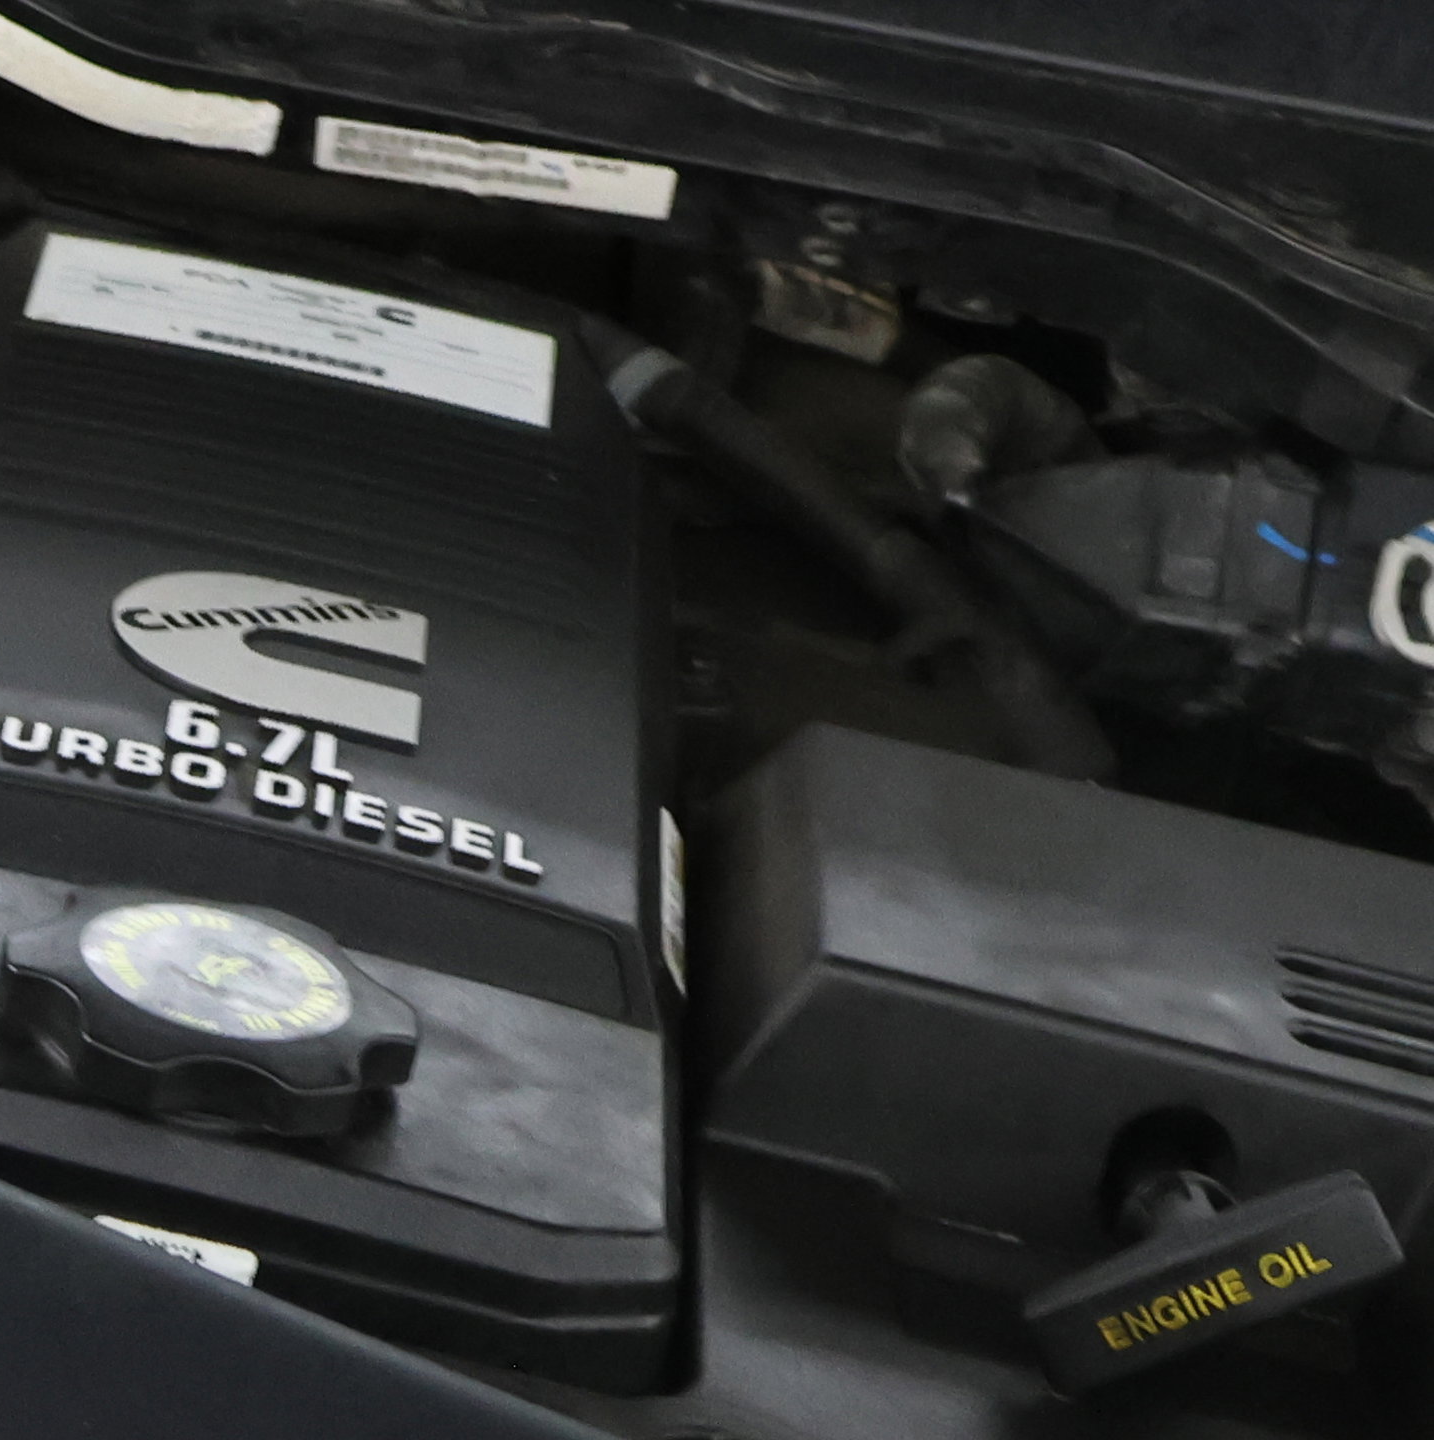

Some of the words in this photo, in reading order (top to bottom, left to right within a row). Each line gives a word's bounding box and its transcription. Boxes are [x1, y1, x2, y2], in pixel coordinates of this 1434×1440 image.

[120, 597, 401, 631] Cummins
[165, 699, 354, 783] 6.7L
[253, 768, 544, 876] DIESEL
[1096, 1268, 1254, 1351] ENGINE
[1258, 1241, 1334, 1289] OIL
